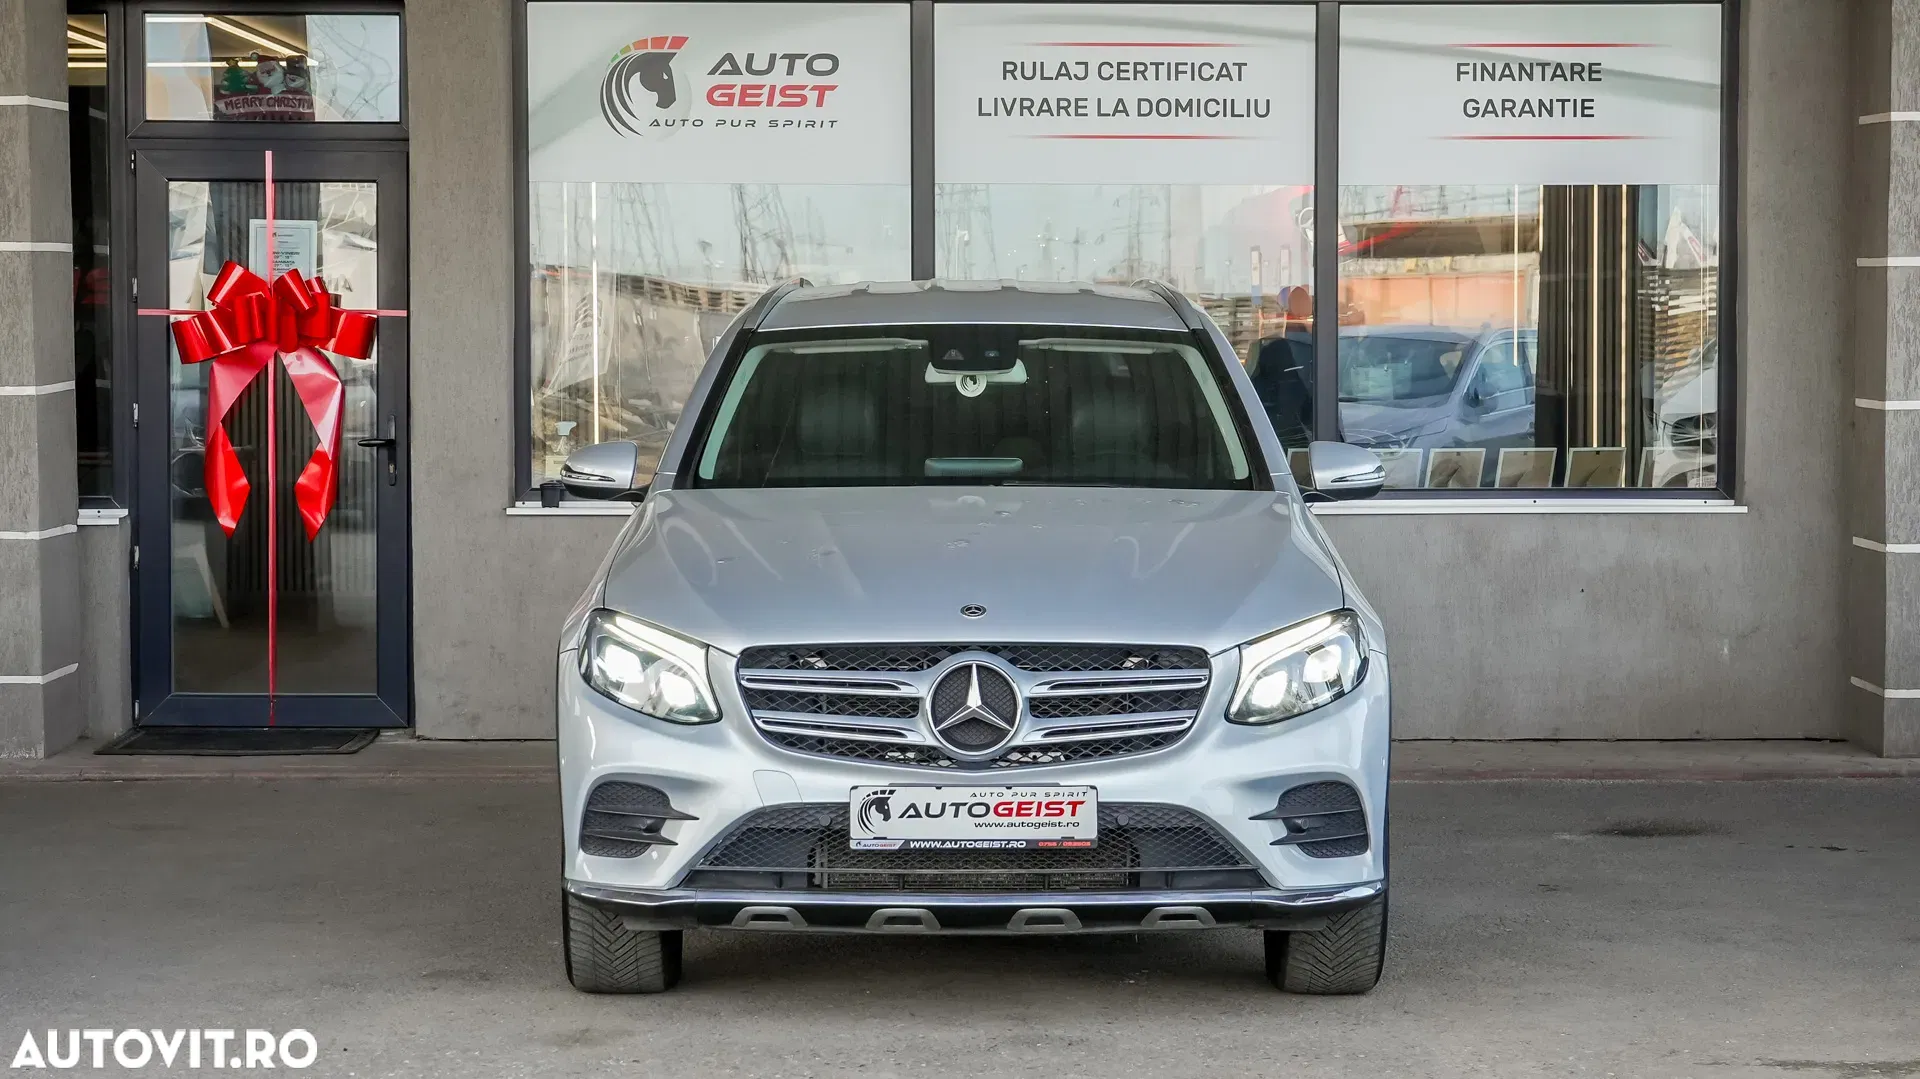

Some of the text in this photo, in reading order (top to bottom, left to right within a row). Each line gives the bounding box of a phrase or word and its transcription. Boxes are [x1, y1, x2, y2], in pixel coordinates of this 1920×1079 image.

[707, 52, 840, 77] AUTO
[1001, 60, 1248, 82] RULAJ CERTIFICAT
[1456, 61, 1603, 83] FINANTARE
[223, 96, 263, 111] MERRY
[706, 83, 839, 108] GEIST
[977, 97, 1271, 119] LIVRARE LA DOMICILIU
[1462, 98, 1596, 119] GARANTIE
[649, 118, 839, 129] AUTO PUR SPIRIT
[898, 800, 1087, 819] AUTOGEIST
[974, 820, 1080, 830] www.autogeist.ro
[909, 840, 1027, 849] WWW.AUTOGEIST.RO
